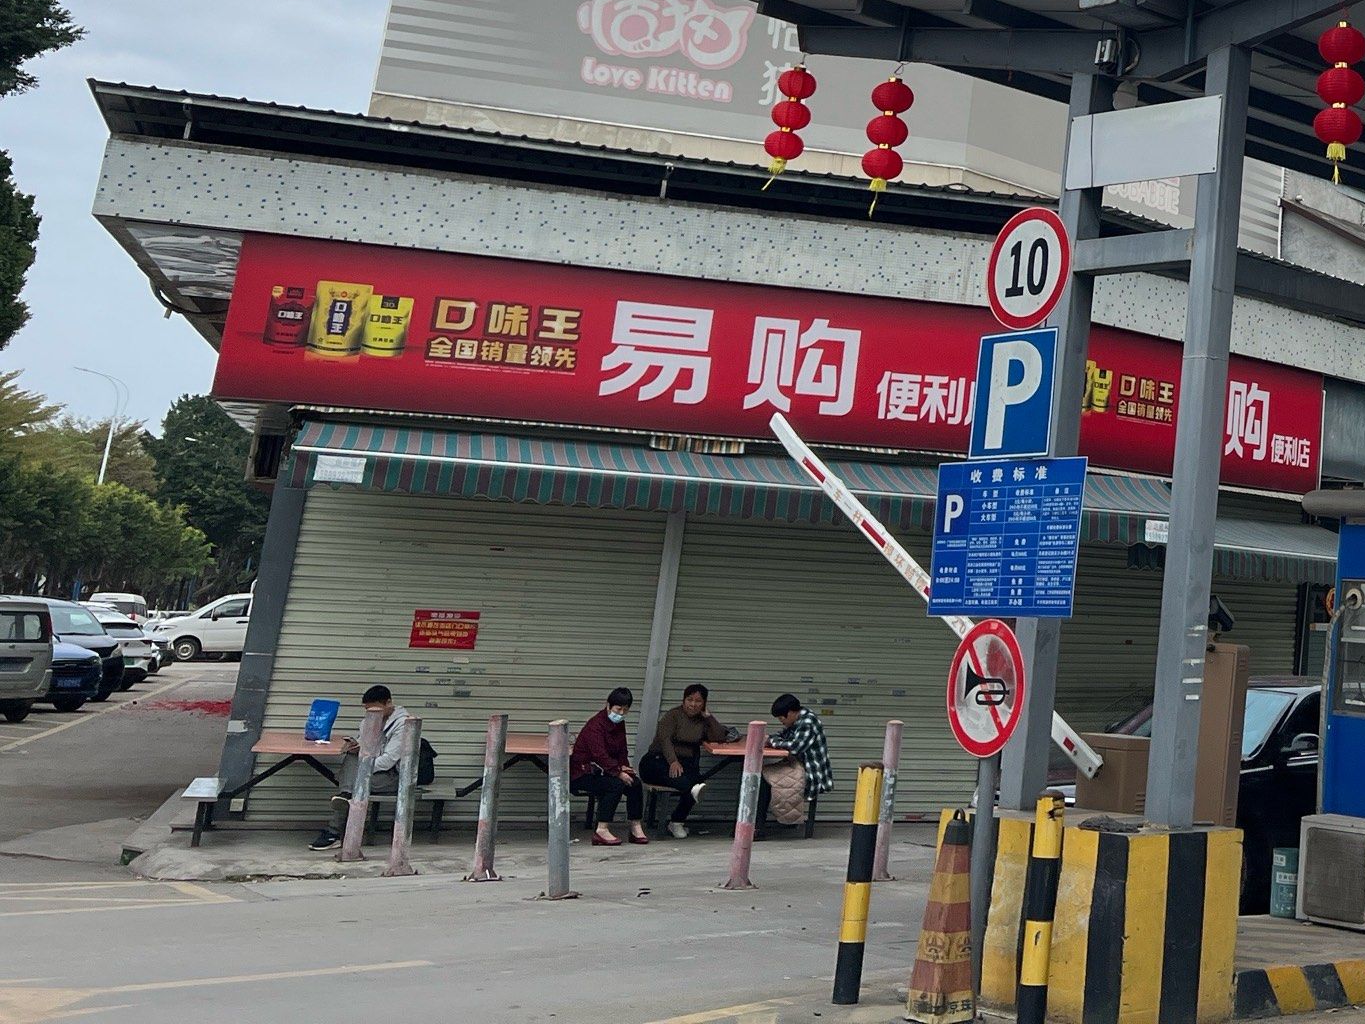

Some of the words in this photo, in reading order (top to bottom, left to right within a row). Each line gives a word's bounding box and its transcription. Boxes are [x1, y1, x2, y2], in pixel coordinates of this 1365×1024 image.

[580, 56, 644, 91] Love
[646, 65, 733, 103] Kitten
[1005, 237, 1049, 298] 10
[435, 298, 581, 341] 口味王
[429, 336, 577, 369] 全国销量领先
[599, 300, 862, 417] 易购
[877, 371, 977, 426] 便利
[984, 340, 1043, 450] P
[1120, 375, 1175, 404] 口味王
[1117, 400, 1174, 423] 全国销量领先
[1224, 380, 1271, 462] 购
[1270, 433, 1311, 469] 便利店
[970, 466, 1048, 484] 收费标准
[944, 494, 964, 533] P
